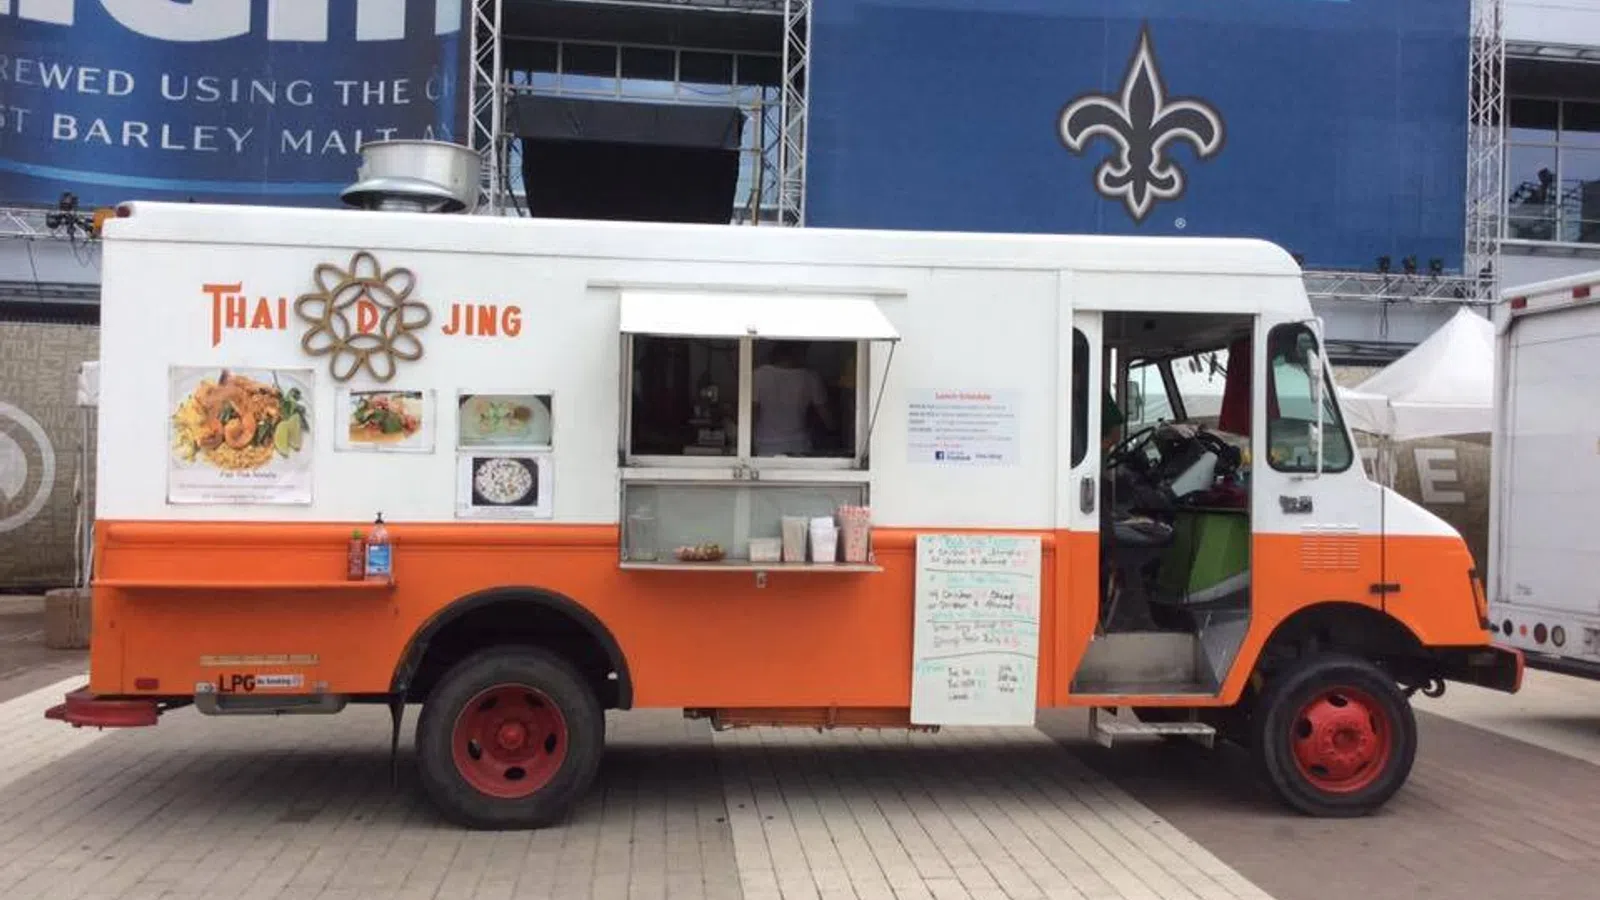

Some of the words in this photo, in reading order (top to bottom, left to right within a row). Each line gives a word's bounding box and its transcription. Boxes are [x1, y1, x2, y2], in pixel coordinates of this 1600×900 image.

[160, 73, 314, 106] USING
[333, 78, 411, 106] THE
[52, 112, 254, 153] BARLEY
[202, 280, 288, 348] THAI
[356, 300, 379, 335] D
[441, 303, 523, 337] JING
[218, 673, 256, 692] LPG
